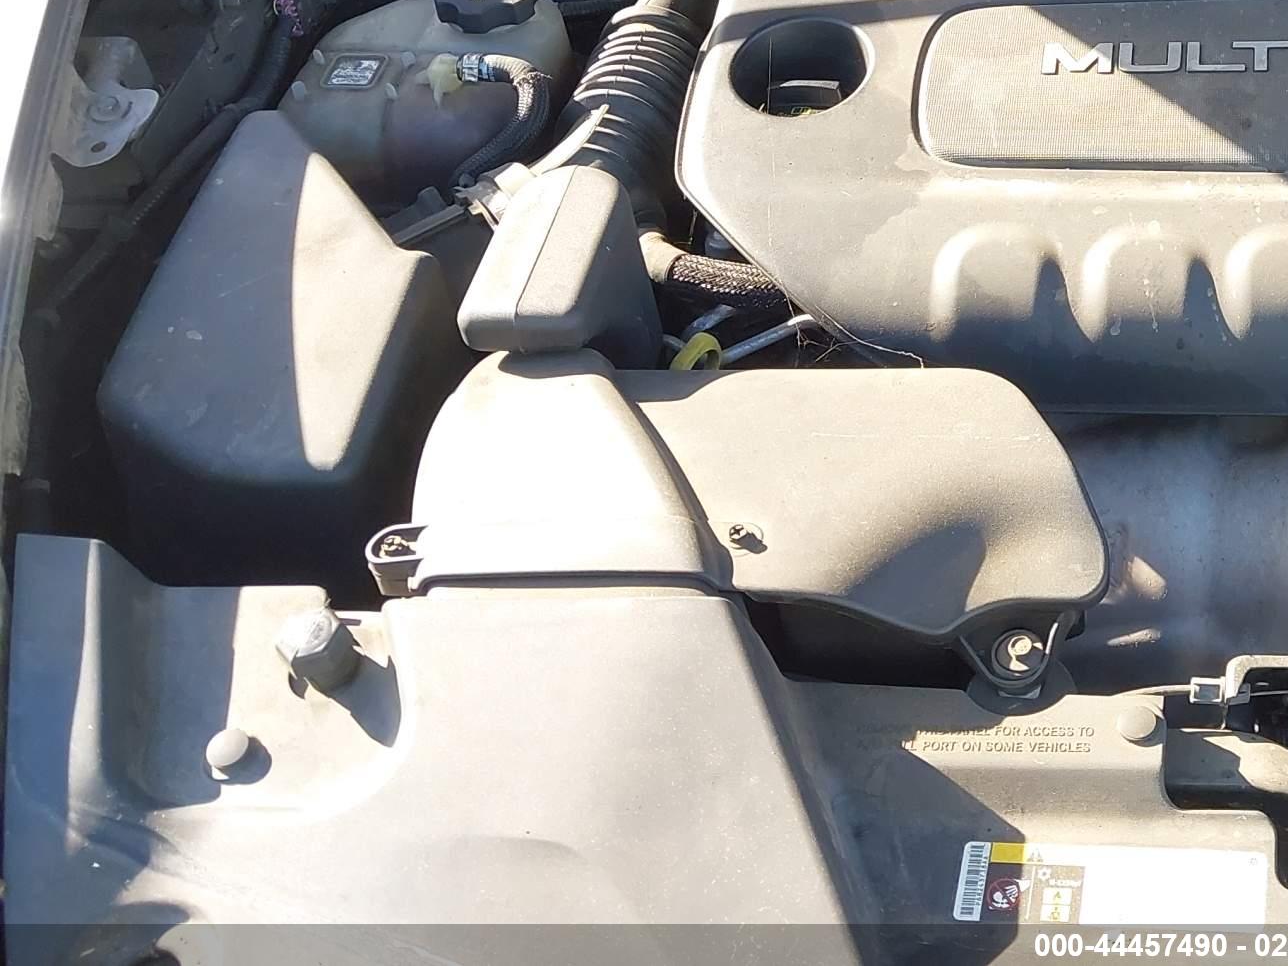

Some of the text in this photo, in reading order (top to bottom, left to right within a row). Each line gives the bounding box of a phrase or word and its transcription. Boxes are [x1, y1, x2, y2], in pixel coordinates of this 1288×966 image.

[995, 725, 1021, 737] FOR
[1023, 725, 1075, 737] ACCESS
[1078, 725, 1095, 737] TO
[922, 741, 957, 752] PORT
[962, 741, 982, 752] ON
[985, 741, 1024, 753] SOME
[1028, 741, 1091, 753] VEHICLES
